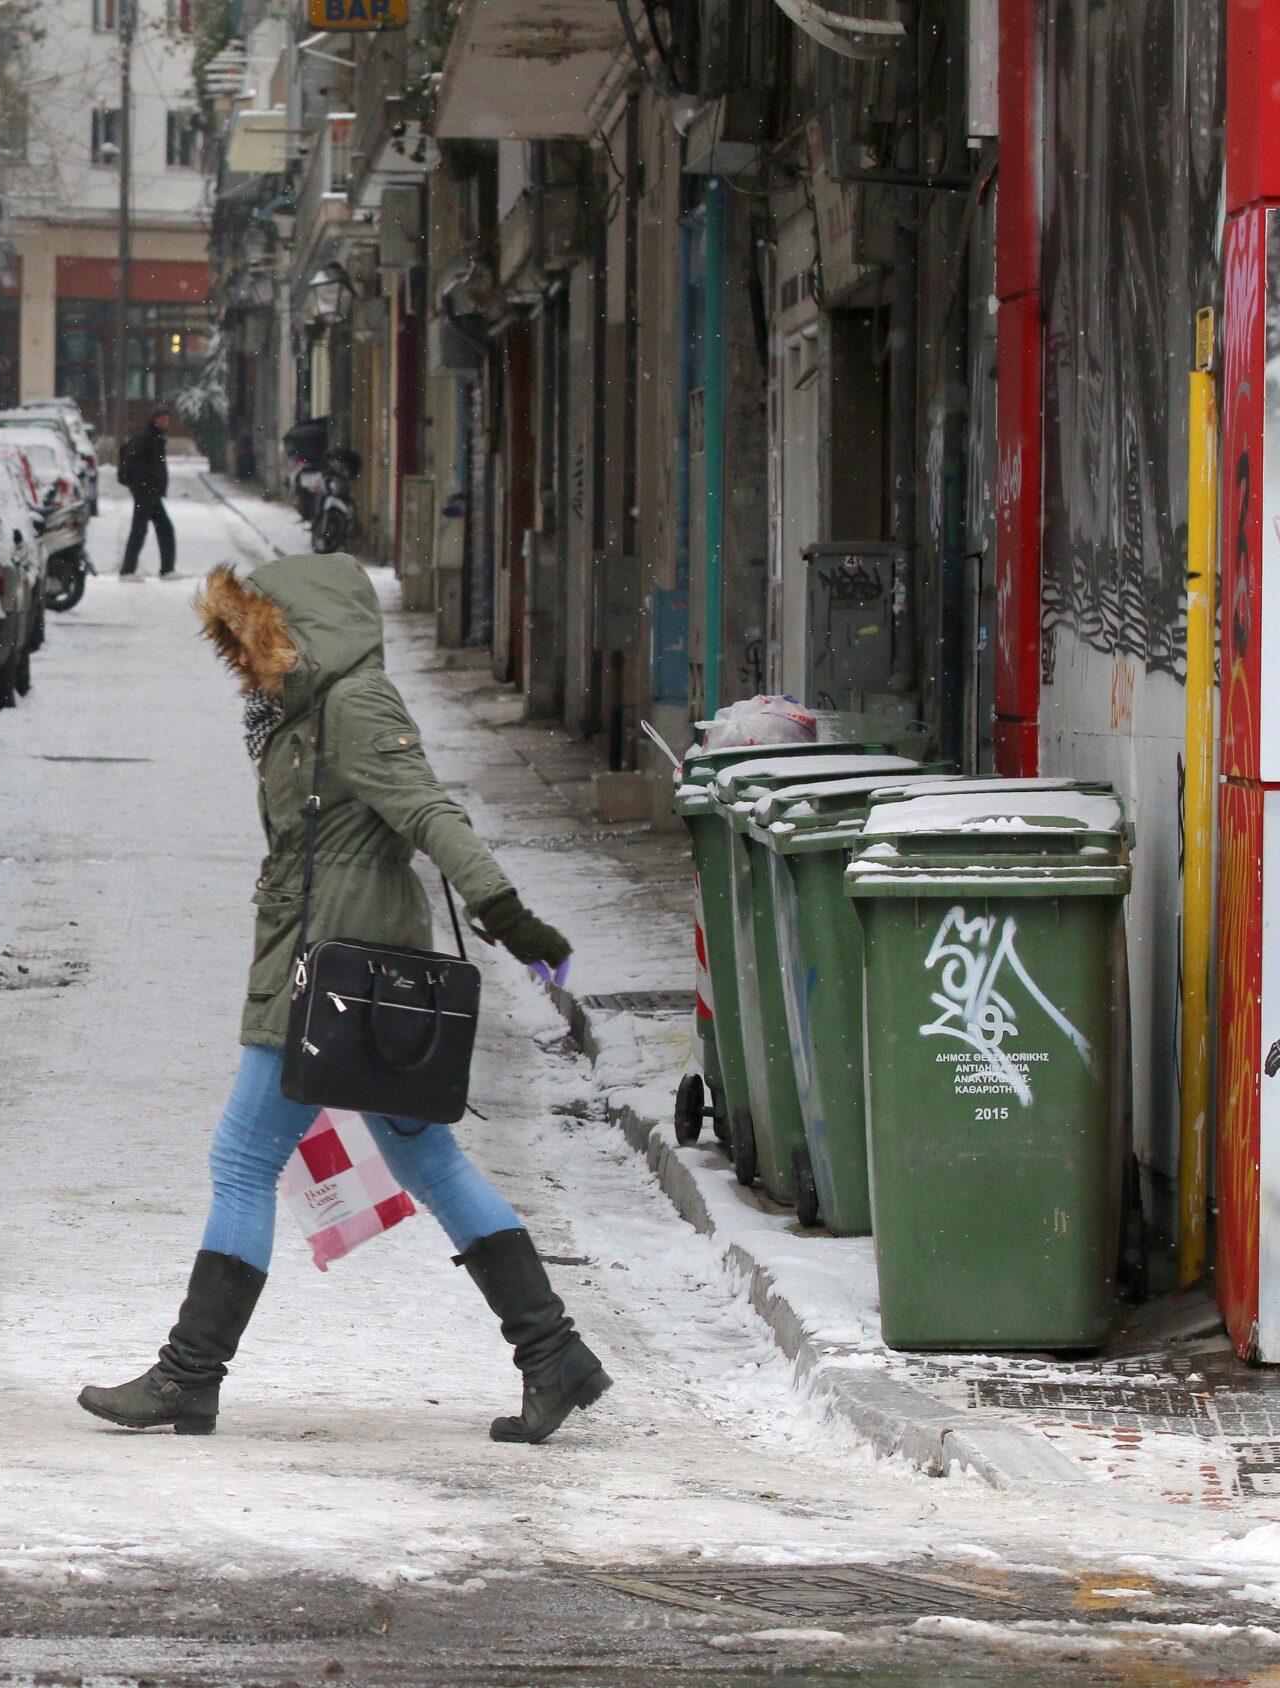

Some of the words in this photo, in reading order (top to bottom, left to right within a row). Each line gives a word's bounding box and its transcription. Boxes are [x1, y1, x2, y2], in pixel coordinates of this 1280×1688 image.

[935, 1053, 972, 1062] ΔΗΜΟΣ
[973, 1052, 1050, 1062] ΘΕΣΣΛΟΝΙΚΗΣ
[974, 1107, 1009, 1120] 2015
